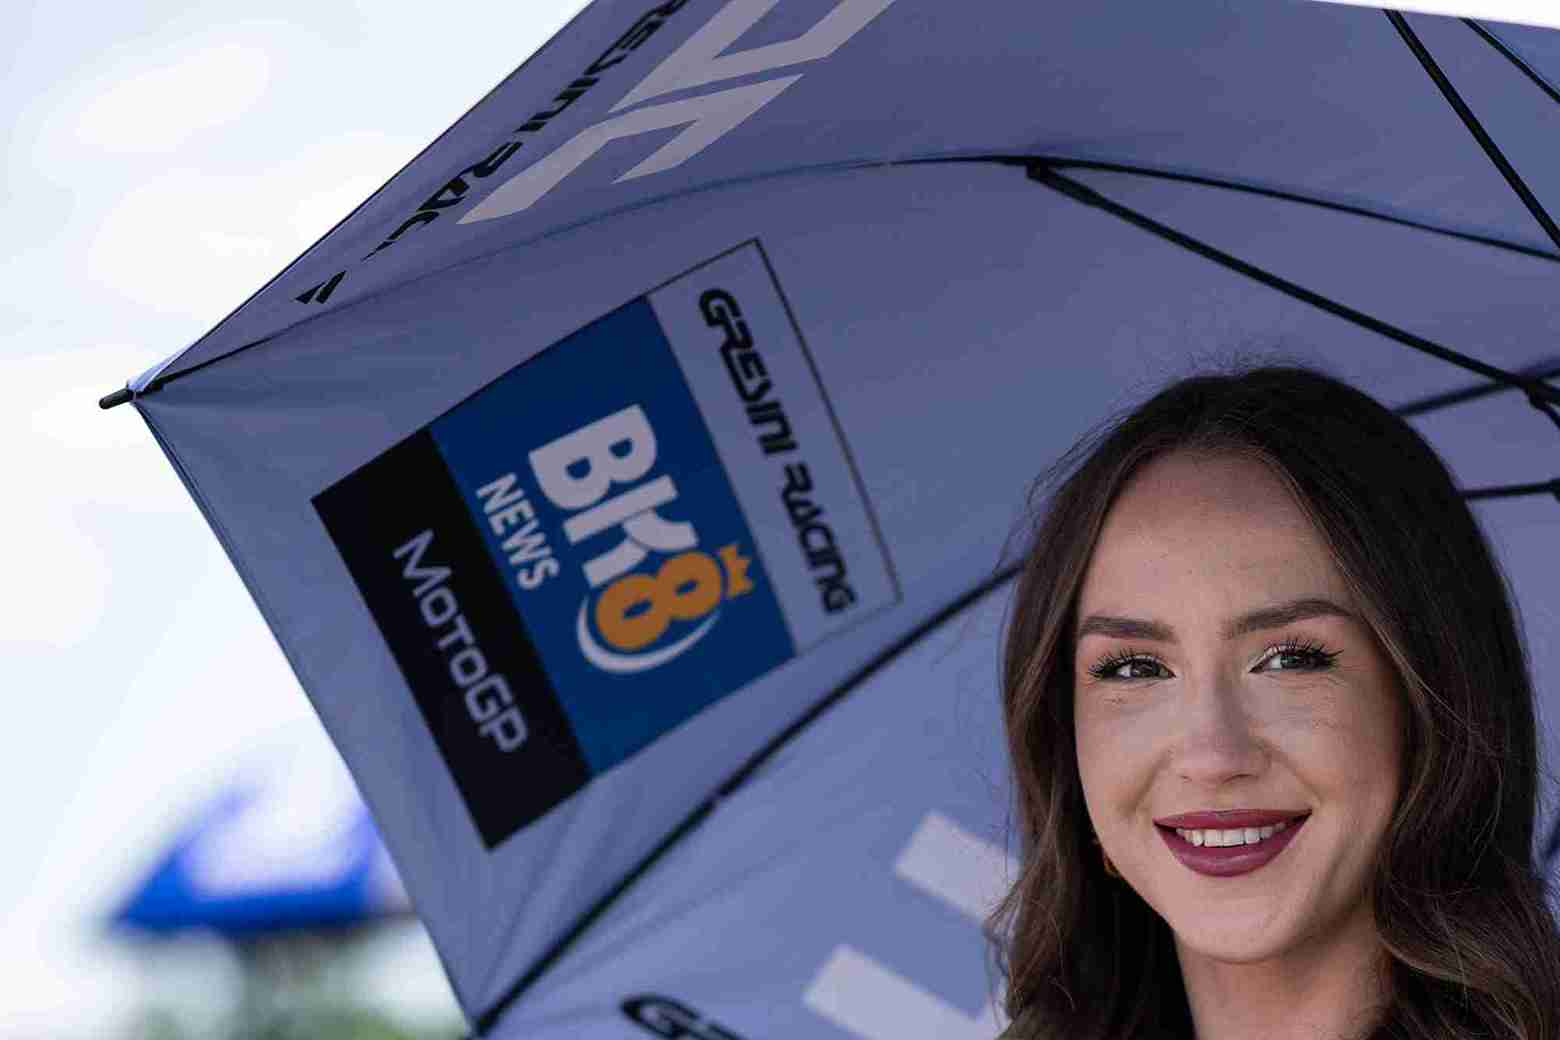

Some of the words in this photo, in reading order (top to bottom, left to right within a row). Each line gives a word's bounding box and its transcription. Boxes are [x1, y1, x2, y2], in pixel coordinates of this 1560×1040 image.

[475, 472, 559, 591] NEWS
[528, 402, 724, 651] BK8
[699, 288, 795, 456] GRESINI
[780, 460, 857, 615] RACING
